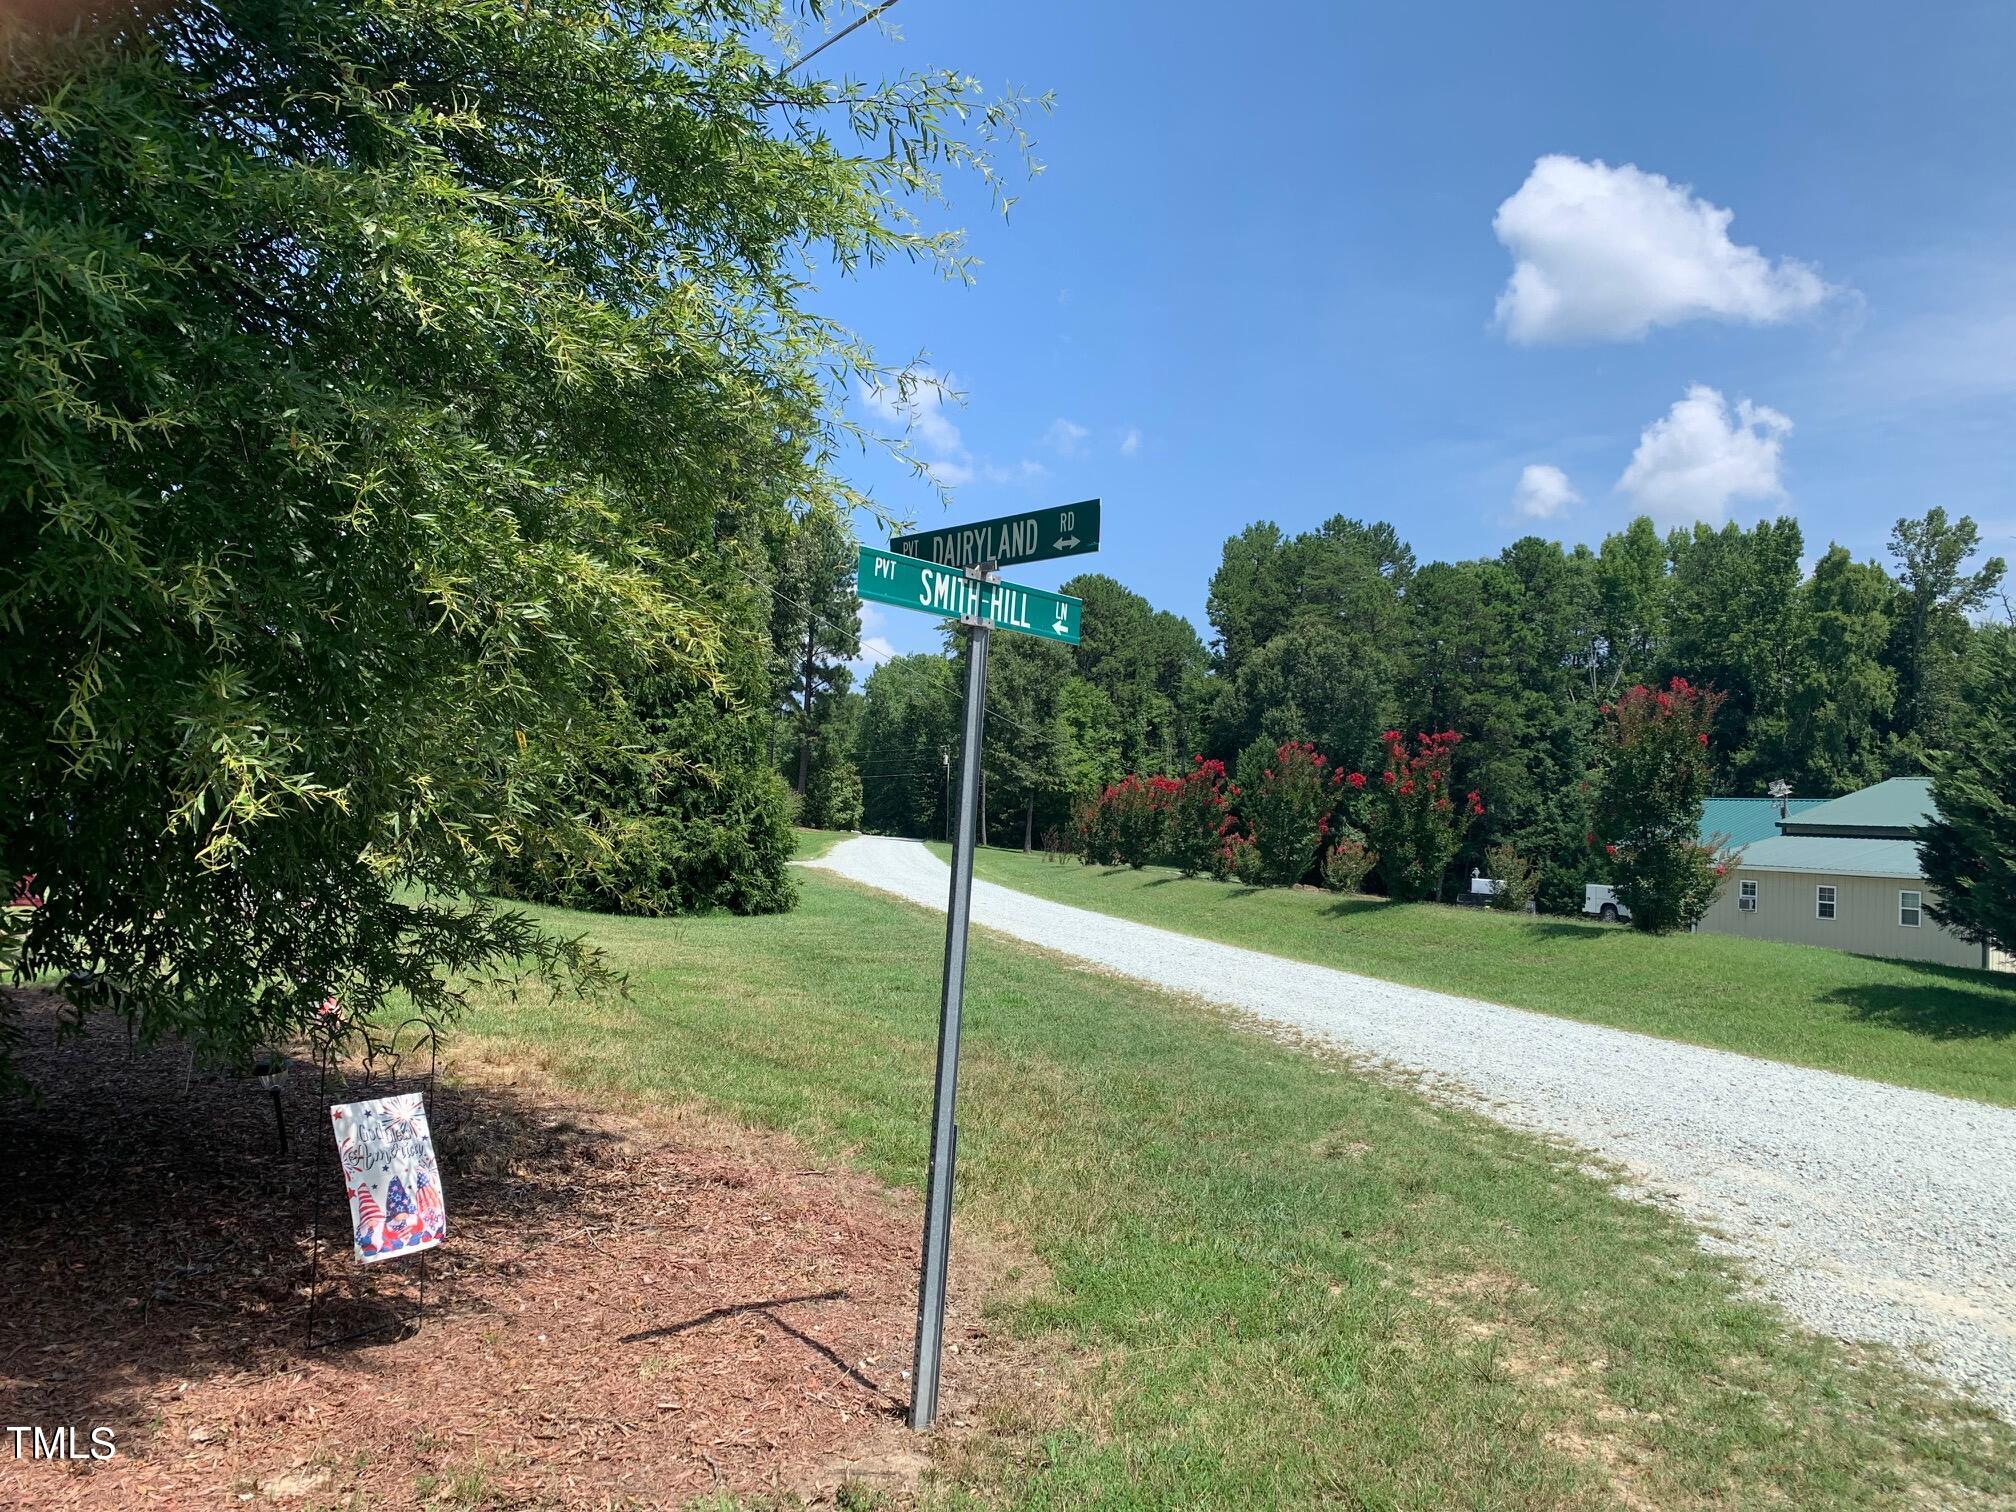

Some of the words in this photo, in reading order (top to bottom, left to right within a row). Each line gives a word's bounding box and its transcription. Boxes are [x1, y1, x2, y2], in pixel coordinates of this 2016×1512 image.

[902, 540, 919, 557] PVT
[933, 519, 1038, 566] DAIRYLAND
[1060, 511, 1075, 532] RD
[874, 557, 897, 580] PVT
[919, 568, 1031, 628] SMITH-HILL
[1055, 601, 1068, 621] LN
[358, 1122, 383, 1142] God
